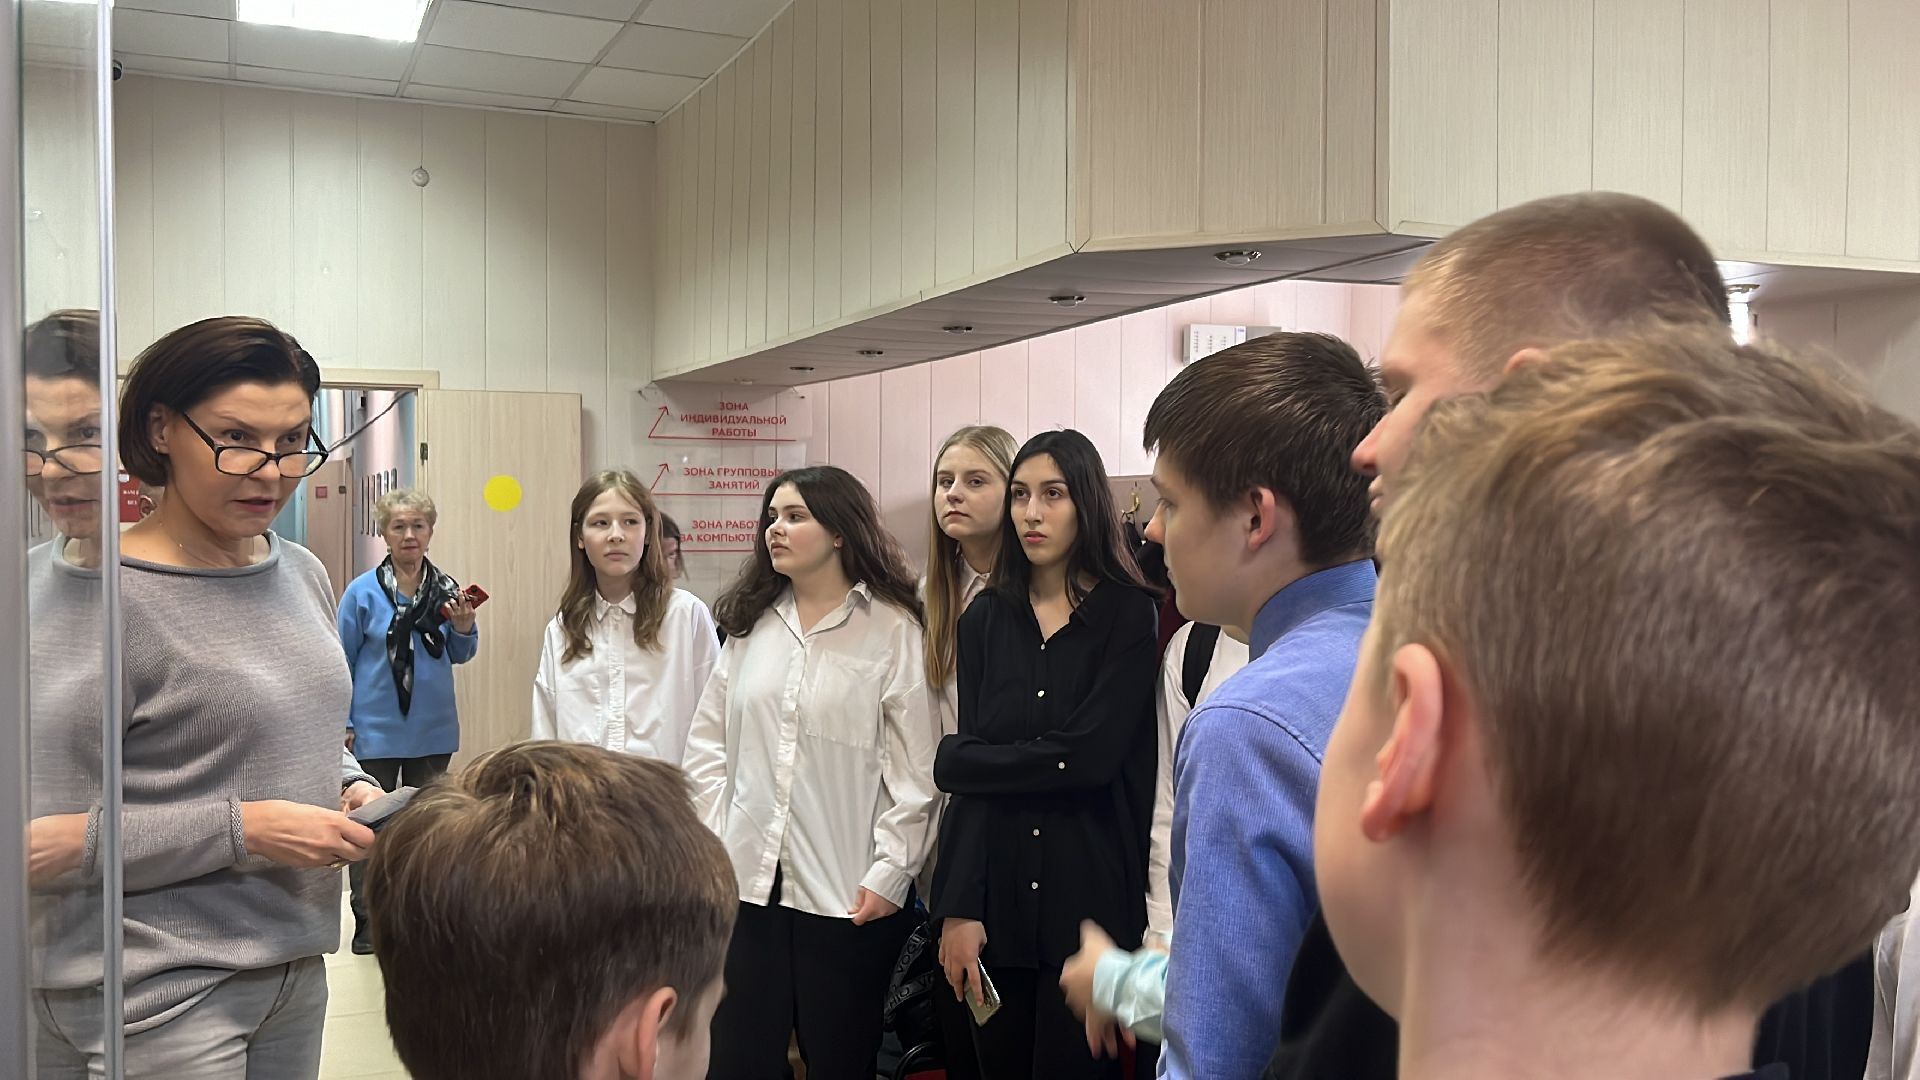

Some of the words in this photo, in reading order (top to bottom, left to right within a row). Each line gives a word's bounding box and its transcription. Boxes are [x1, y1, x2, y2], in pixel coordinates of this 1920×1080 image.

[719, 402, 749, 411] ЗОНА
[680, 413, 787, 425] ИНДИВИДУАЛЬНОЙ
[712, 428, 757, 437] РАБОТЫ
[683, 467, 714, 476] ЗОНА
[709, 480, 760, 489] ЗАНЯТИЙ
[692, 520, 722, 529] ЗОНА
[726, 520, 760, 529] РАБОТ
[697, 533, 757, 542] КОМПЬЮТЕ
